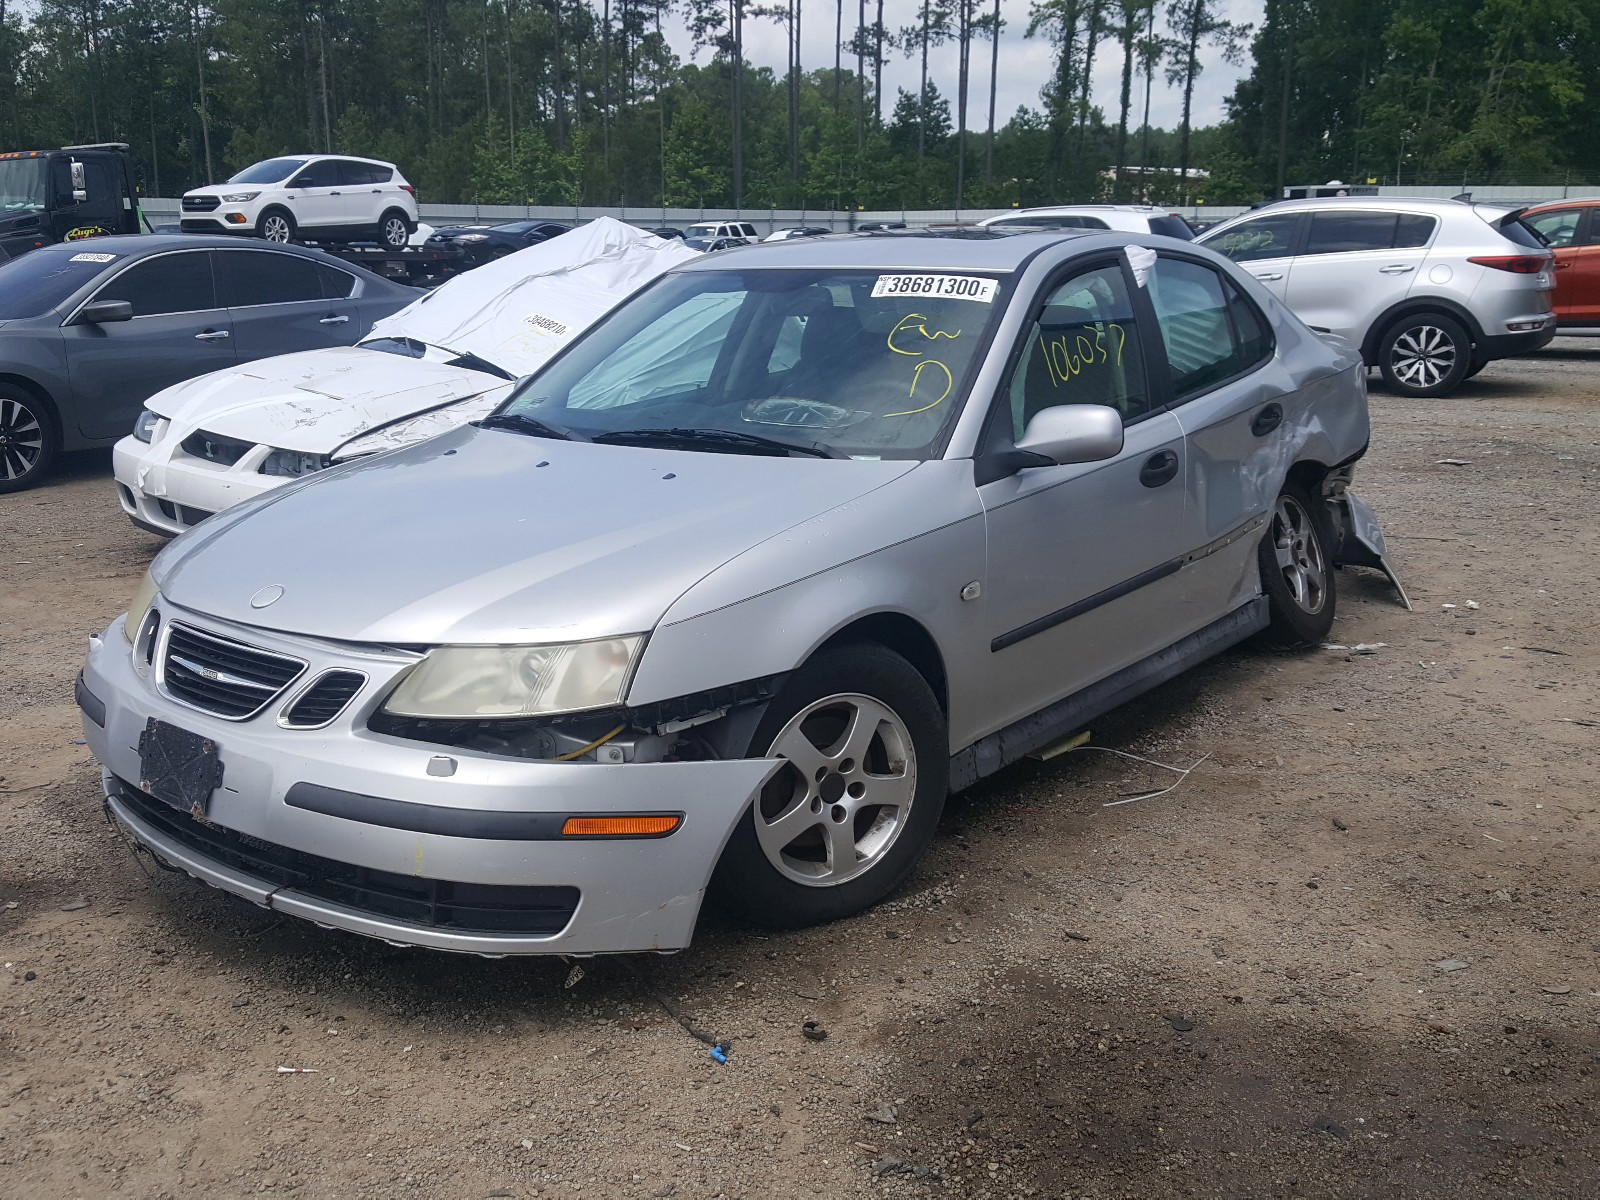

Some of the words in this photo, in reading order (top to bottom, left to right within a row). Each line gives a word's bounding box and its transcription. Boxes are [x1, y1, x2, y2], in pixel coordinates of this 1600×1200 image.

[70, 226, 102, 237] Lugo's
[888, 277, 980, 296] 38681300
[980, 286, 989, 296] F
[1039, 323, 1125, 388] 106037
